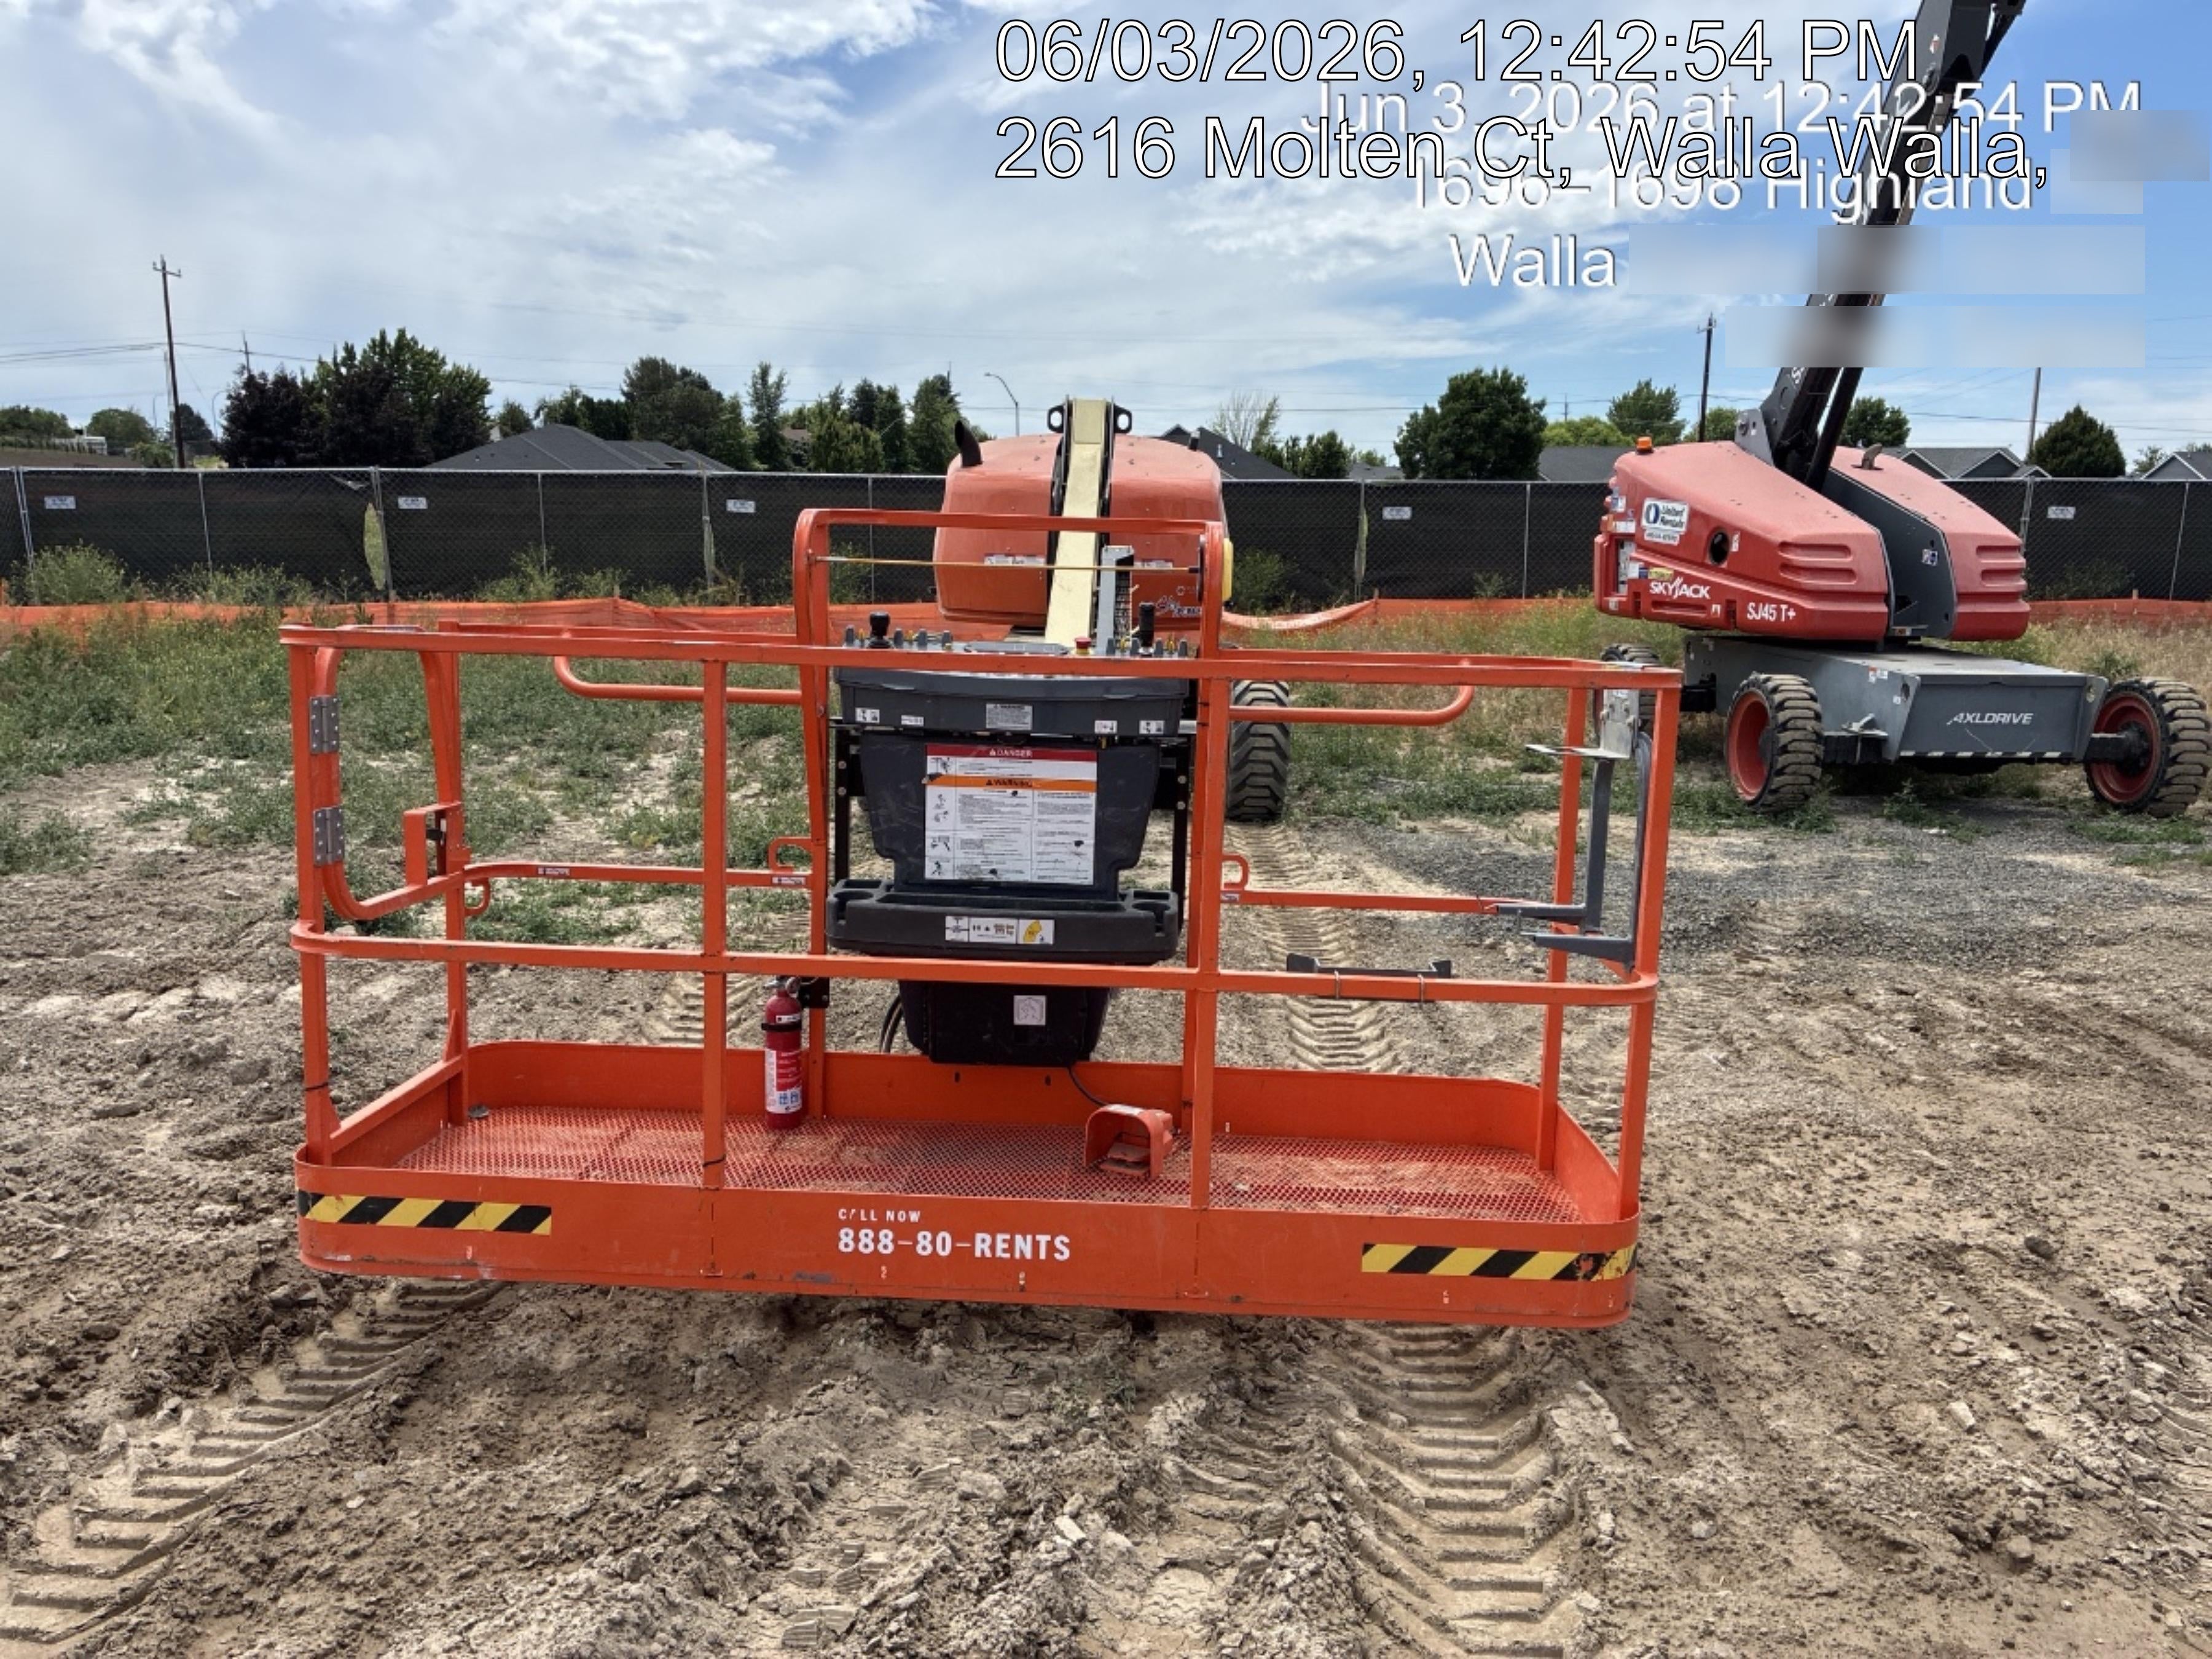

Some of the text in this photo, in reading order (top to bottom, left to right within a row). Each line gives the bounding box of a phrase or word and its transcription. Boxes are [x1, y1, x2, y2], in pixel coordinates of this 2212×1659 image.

[1649, 576, 1711, 598] SKYJACK
[1746, 602, 1797, 621] SJ45 T+
[886, 1210, 920, 1223] NOW
[838, 1227, 1070, 1261] 888-80-RENTS
